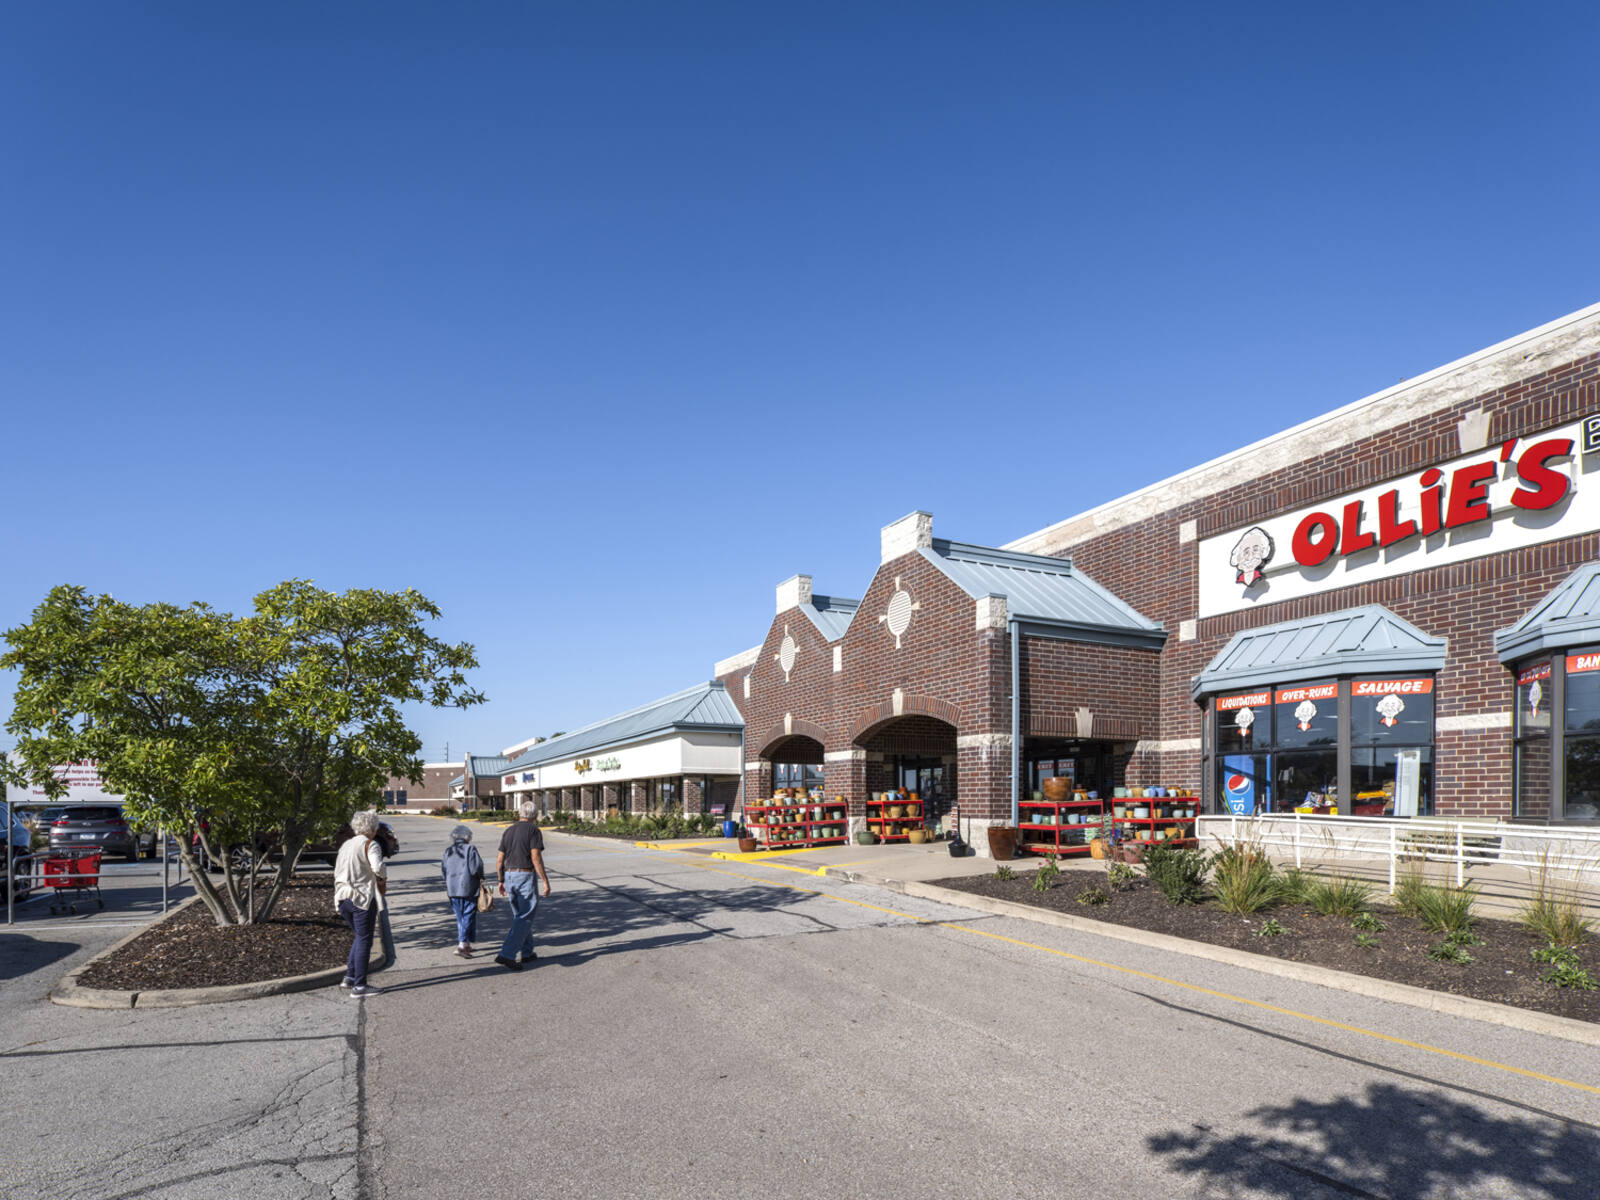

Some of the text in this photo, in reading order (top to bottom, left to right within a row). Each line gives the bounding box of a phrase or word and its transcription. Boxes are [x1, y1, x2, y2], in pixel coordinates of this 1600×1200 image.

[1282, 686, 1334, 701] OVER-RUNS
[1357, 681, 1423, 694] SALVAGE
[1221, 694, 1268, 709] LIQUIDATIONS
